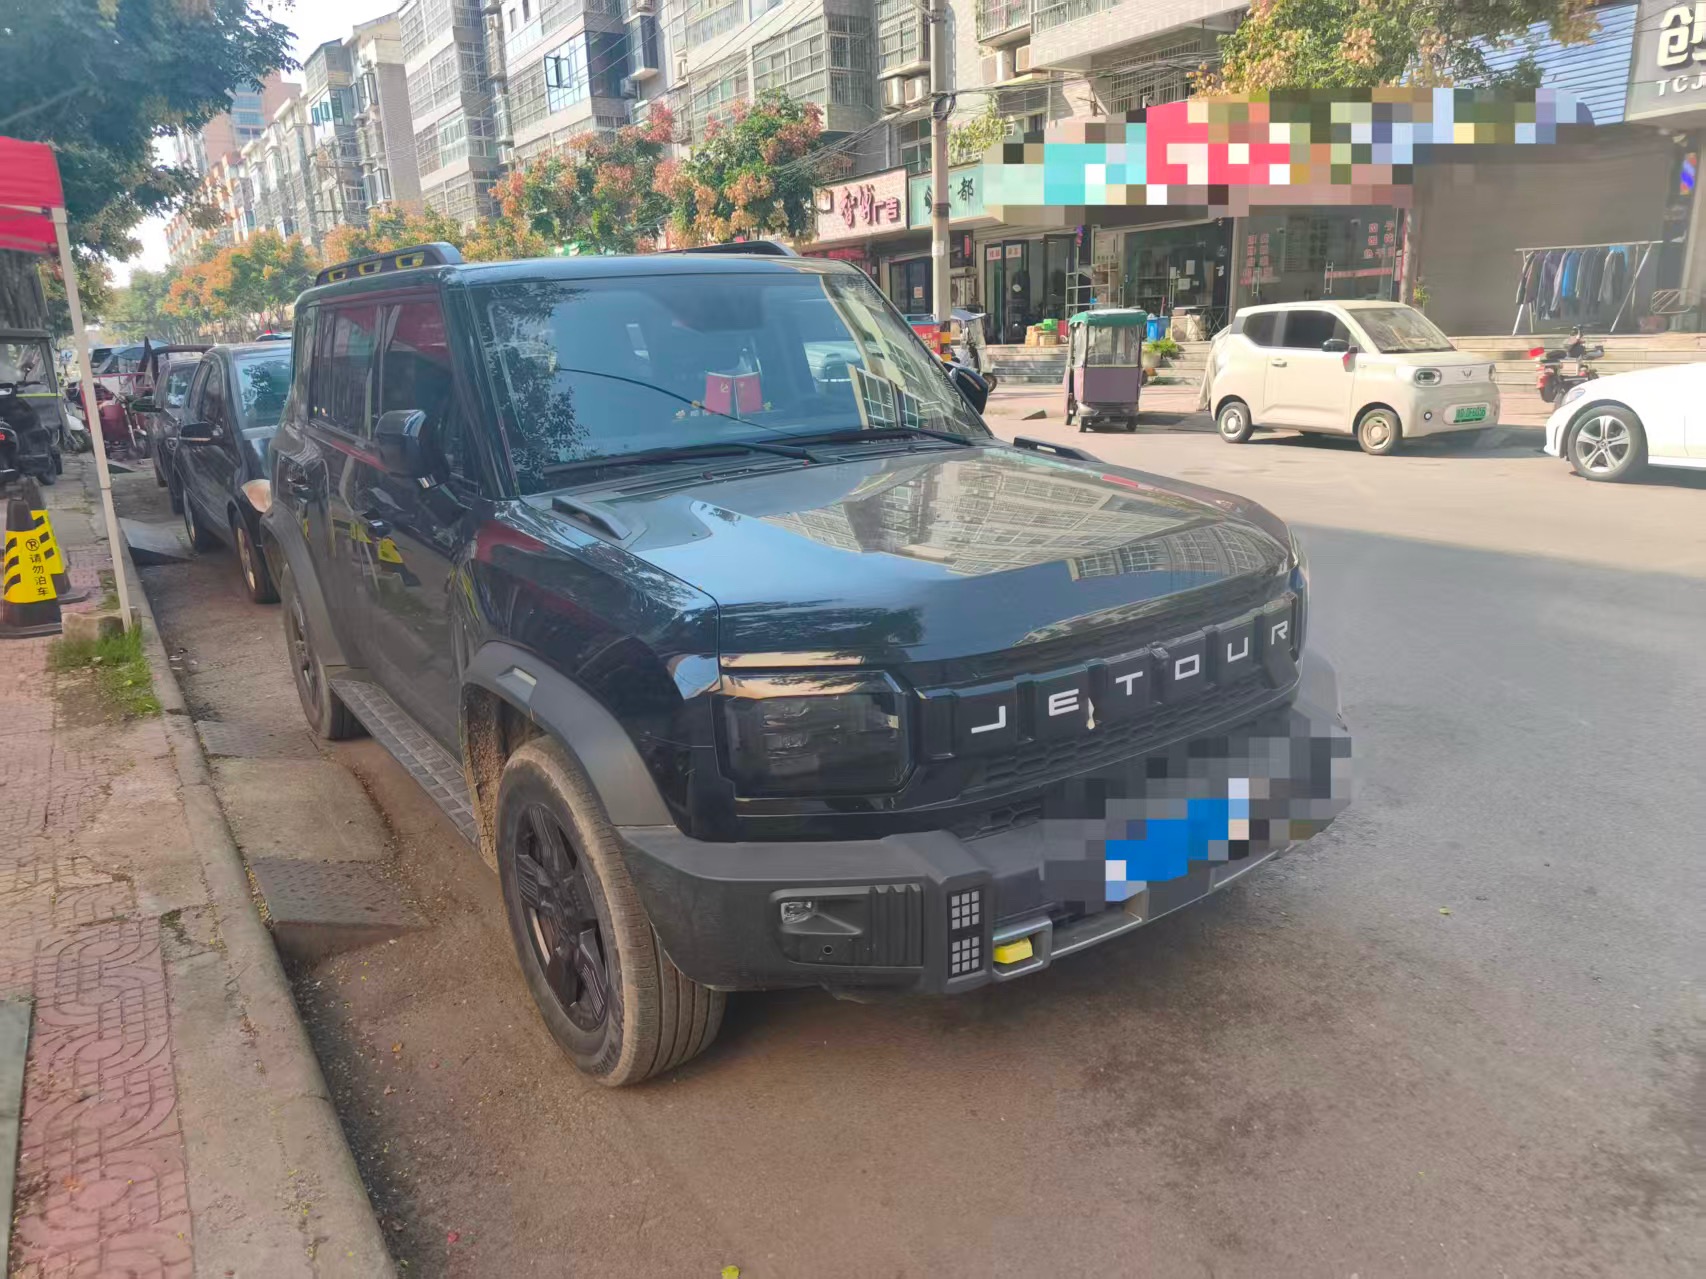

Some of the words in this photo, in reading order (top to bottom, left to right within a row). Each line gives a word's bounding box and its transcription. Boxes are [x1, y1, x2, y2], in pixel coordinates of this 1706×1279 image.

[29, 553, 49, 596] 请勿泊车
[970, 620, 1288, 734] JETOUR
